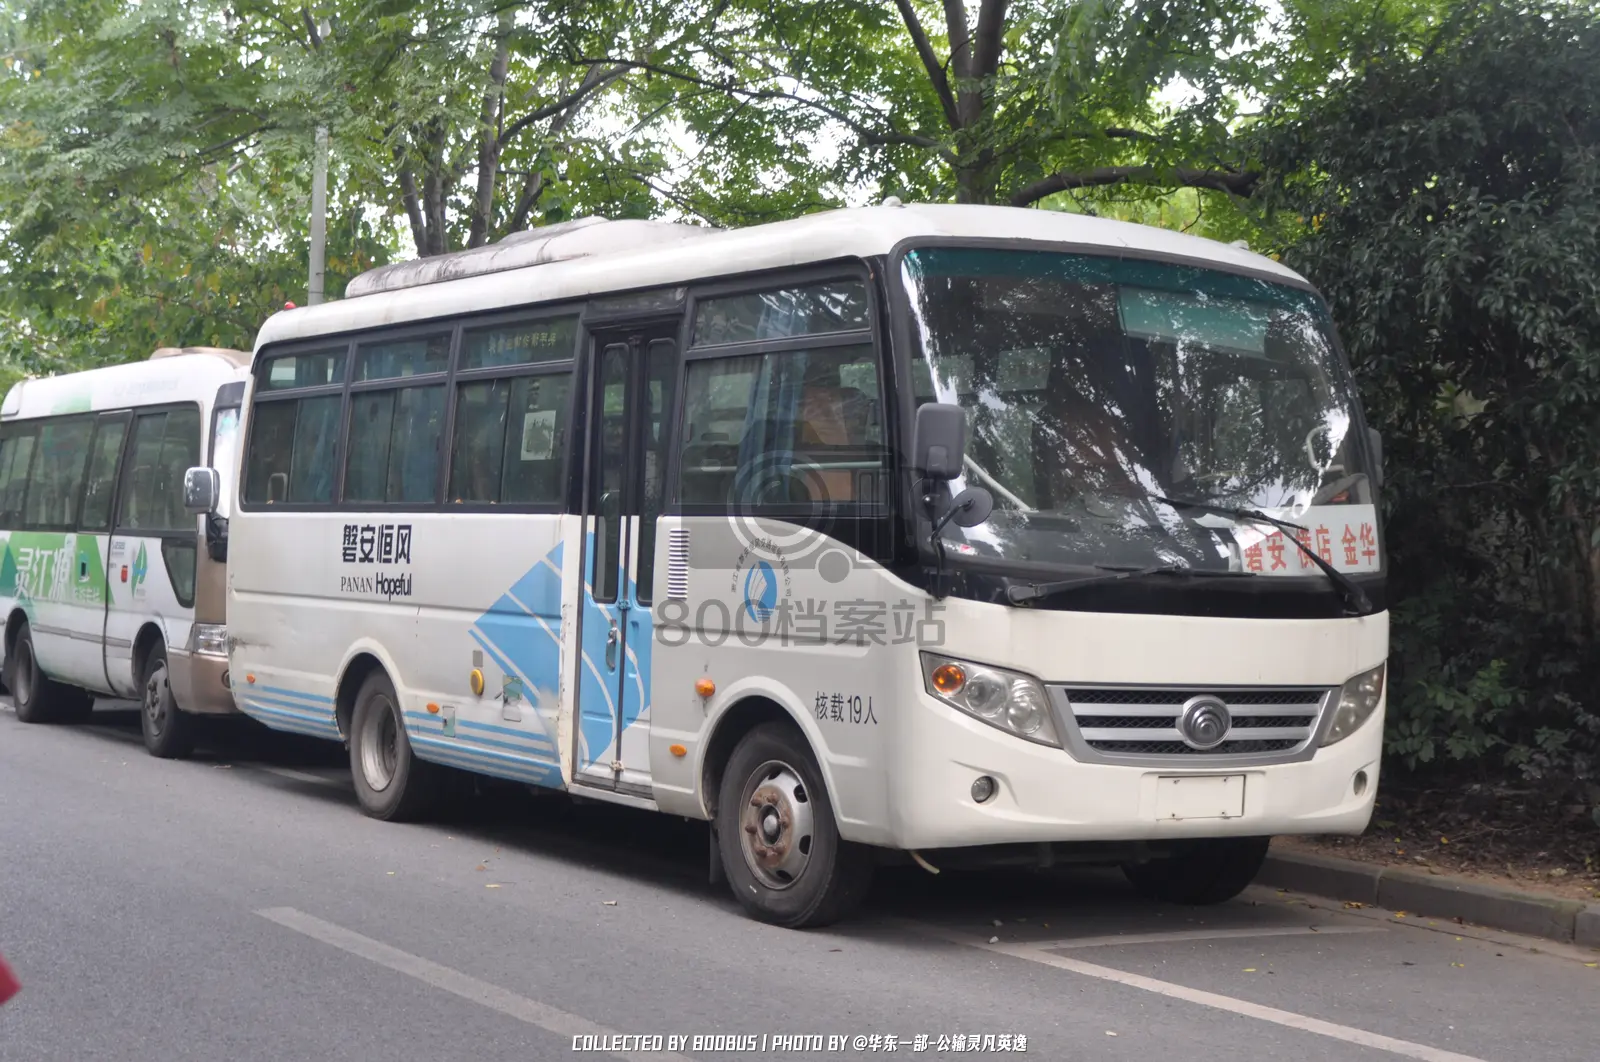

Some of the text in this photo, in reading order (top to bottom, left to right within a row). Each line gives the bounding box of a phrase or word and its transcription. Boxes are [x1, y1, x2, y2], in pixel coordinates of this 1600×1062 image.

[342, 524, 412, 564] 磐安恒风
[1341, 522, 1376, 566] 金华
[340, 572, 412, 602] PANAN Hopeful
[815, 690, 878, 725] 核载19人
